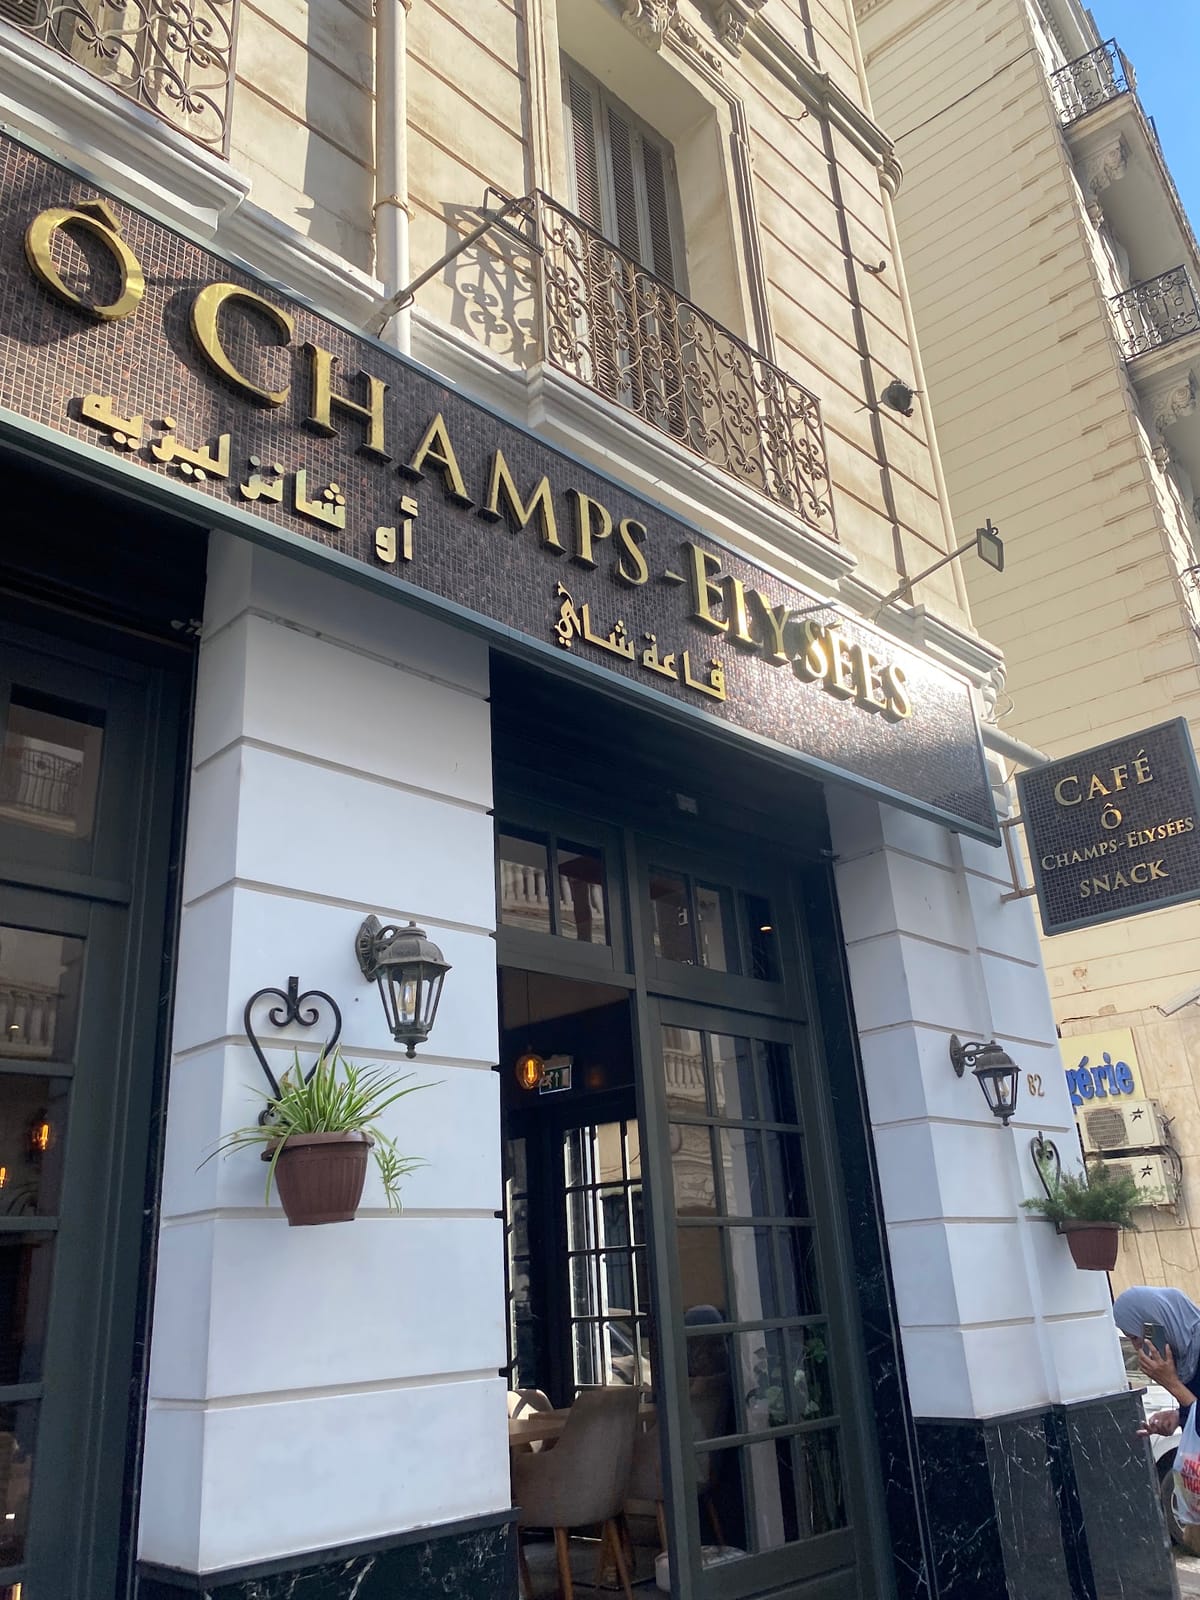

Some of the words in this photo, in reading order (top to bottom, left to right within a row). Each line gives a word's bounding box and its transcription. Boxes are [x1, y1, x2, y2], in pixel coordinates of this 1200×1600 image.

[25, 198, 146, 322] Ô
[375, 494, 418, 563] أو
[642, 631, 727, 701] قاعة
[1053, 748, 1153, 808] CAFÉ
[1100, 802, 1123, 830] Ô
[1079, 859, 1170, 899] SNACK
[1026, 1073, 1045, 1097] 82
